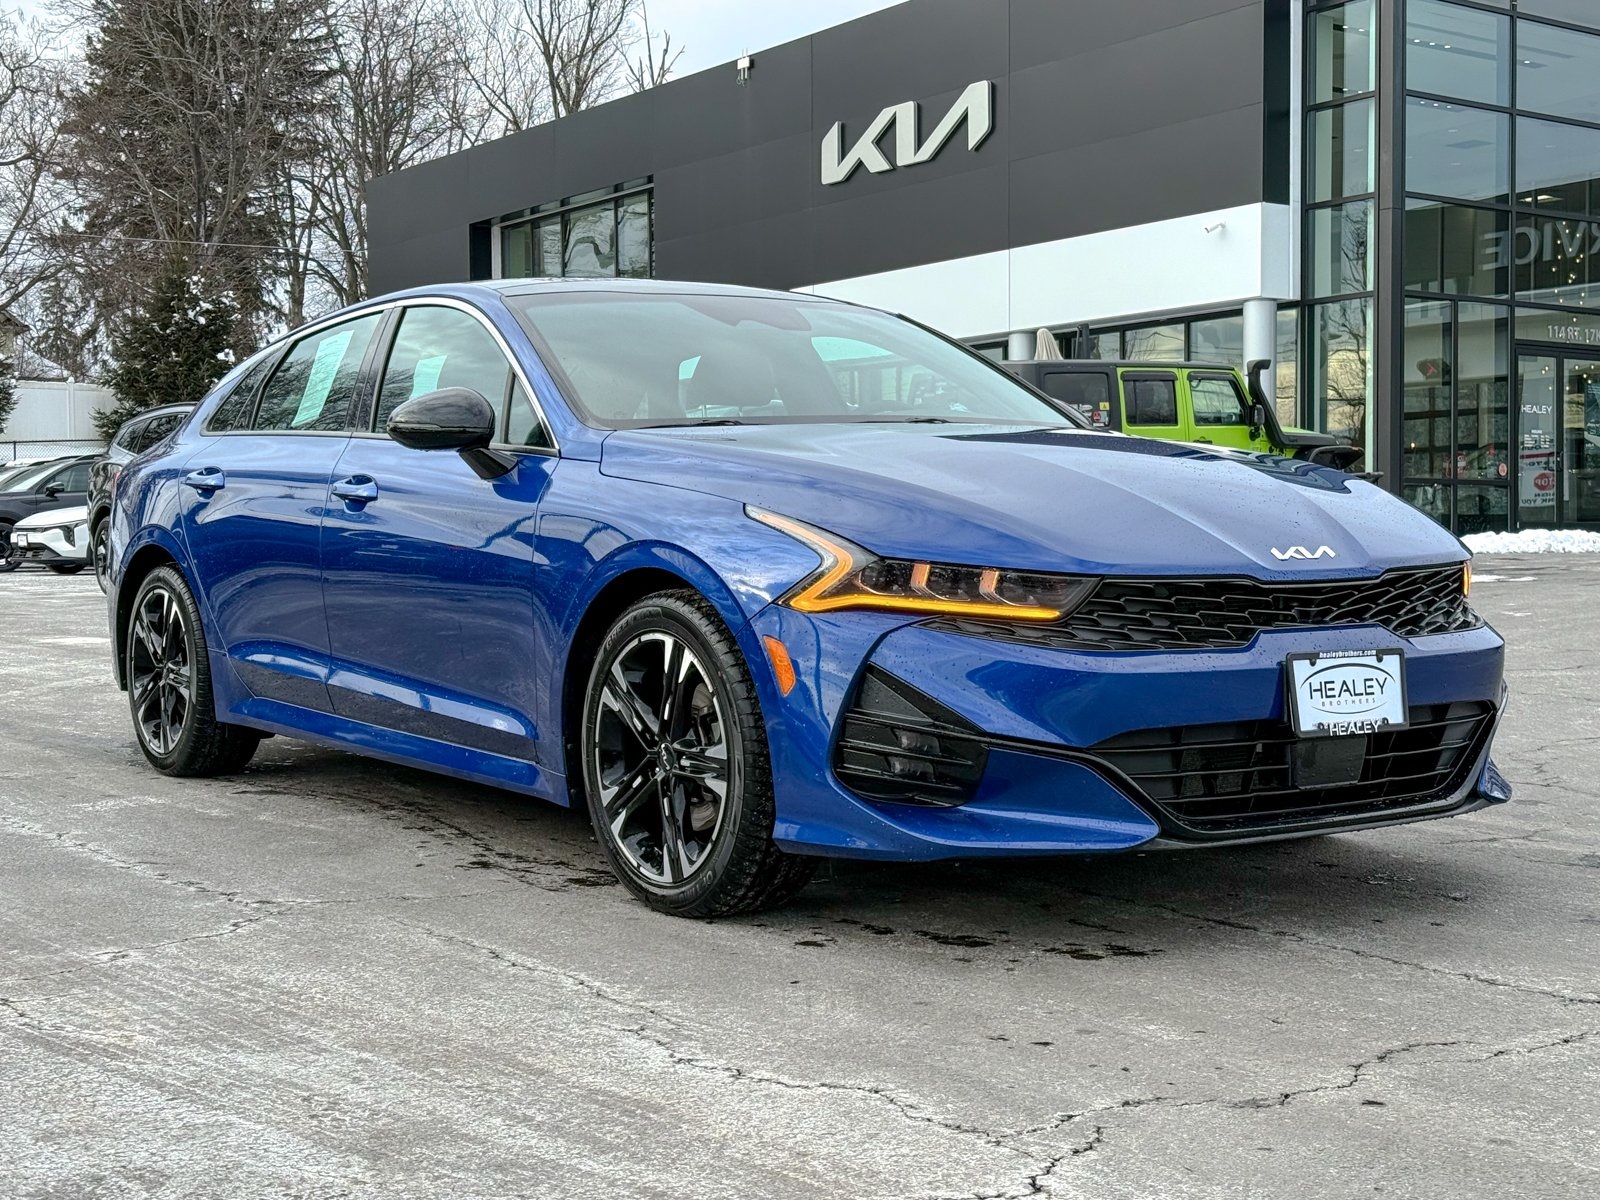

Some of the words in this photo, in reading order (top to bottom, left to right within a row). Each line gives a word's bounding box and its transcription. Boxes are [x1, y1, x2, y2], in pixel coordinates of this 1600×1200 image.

[821, 80, 992, 185] KIA
[1547, 325, 1566, 339] 114
[1521, 404, 1552, 414] HEALEY
[1319, 650, 1377, 658] healeybrothers.com
[1308, 677, 1388, 700] HEALEY
[1321, 698, 1376, 706] BROTHERS
[1329, 720, 1380, 736] HEALEY
